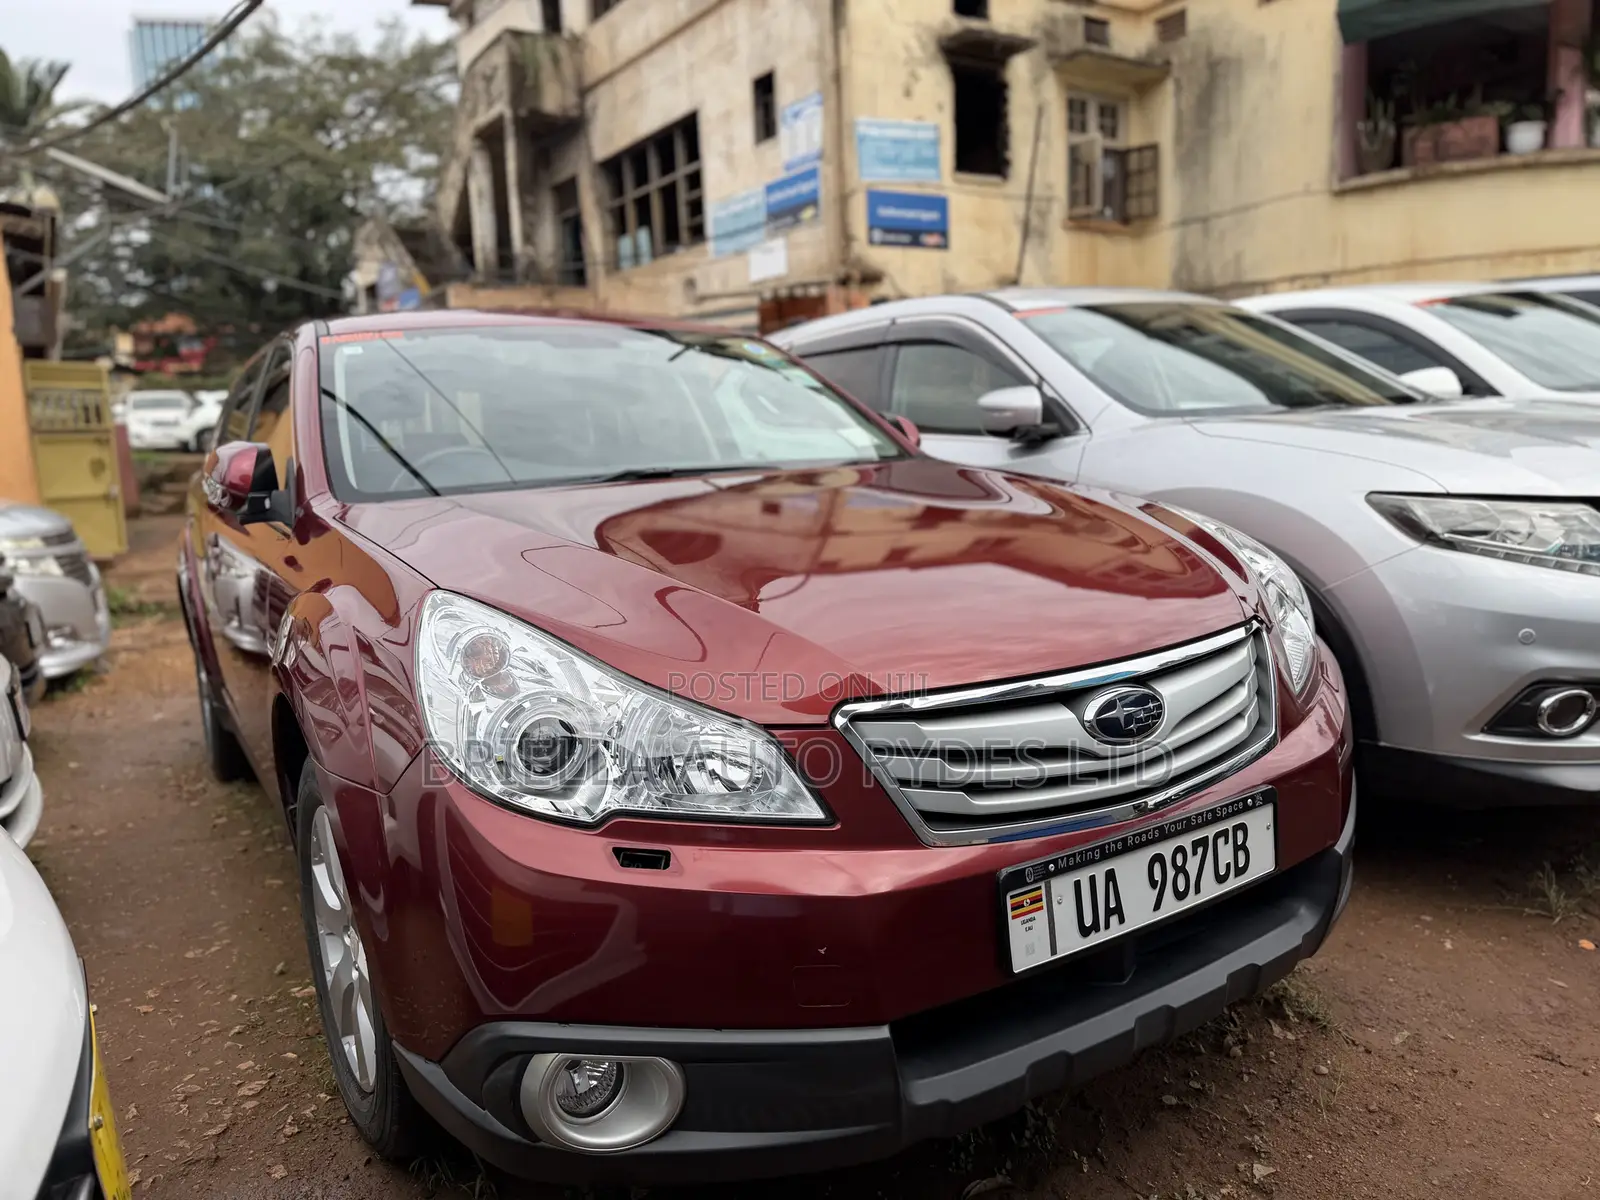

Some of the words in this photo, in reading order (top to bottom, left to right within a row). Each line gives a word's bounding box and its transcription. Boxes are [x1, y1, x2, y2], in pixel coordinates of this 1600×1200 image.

[1057, 850, 1101, 869] Making
[1104, 842, 1124, 855] the
[1127, 828, 1160, 847] Roads
[1164, 820, 1187, 835] Your
[1190, 812, 1213, 827] Safe
[1215, 801, 1245, 818] Space
[1073, 867, 1126, 938] UA
[1148, 821, 1251, 912] 987CB
